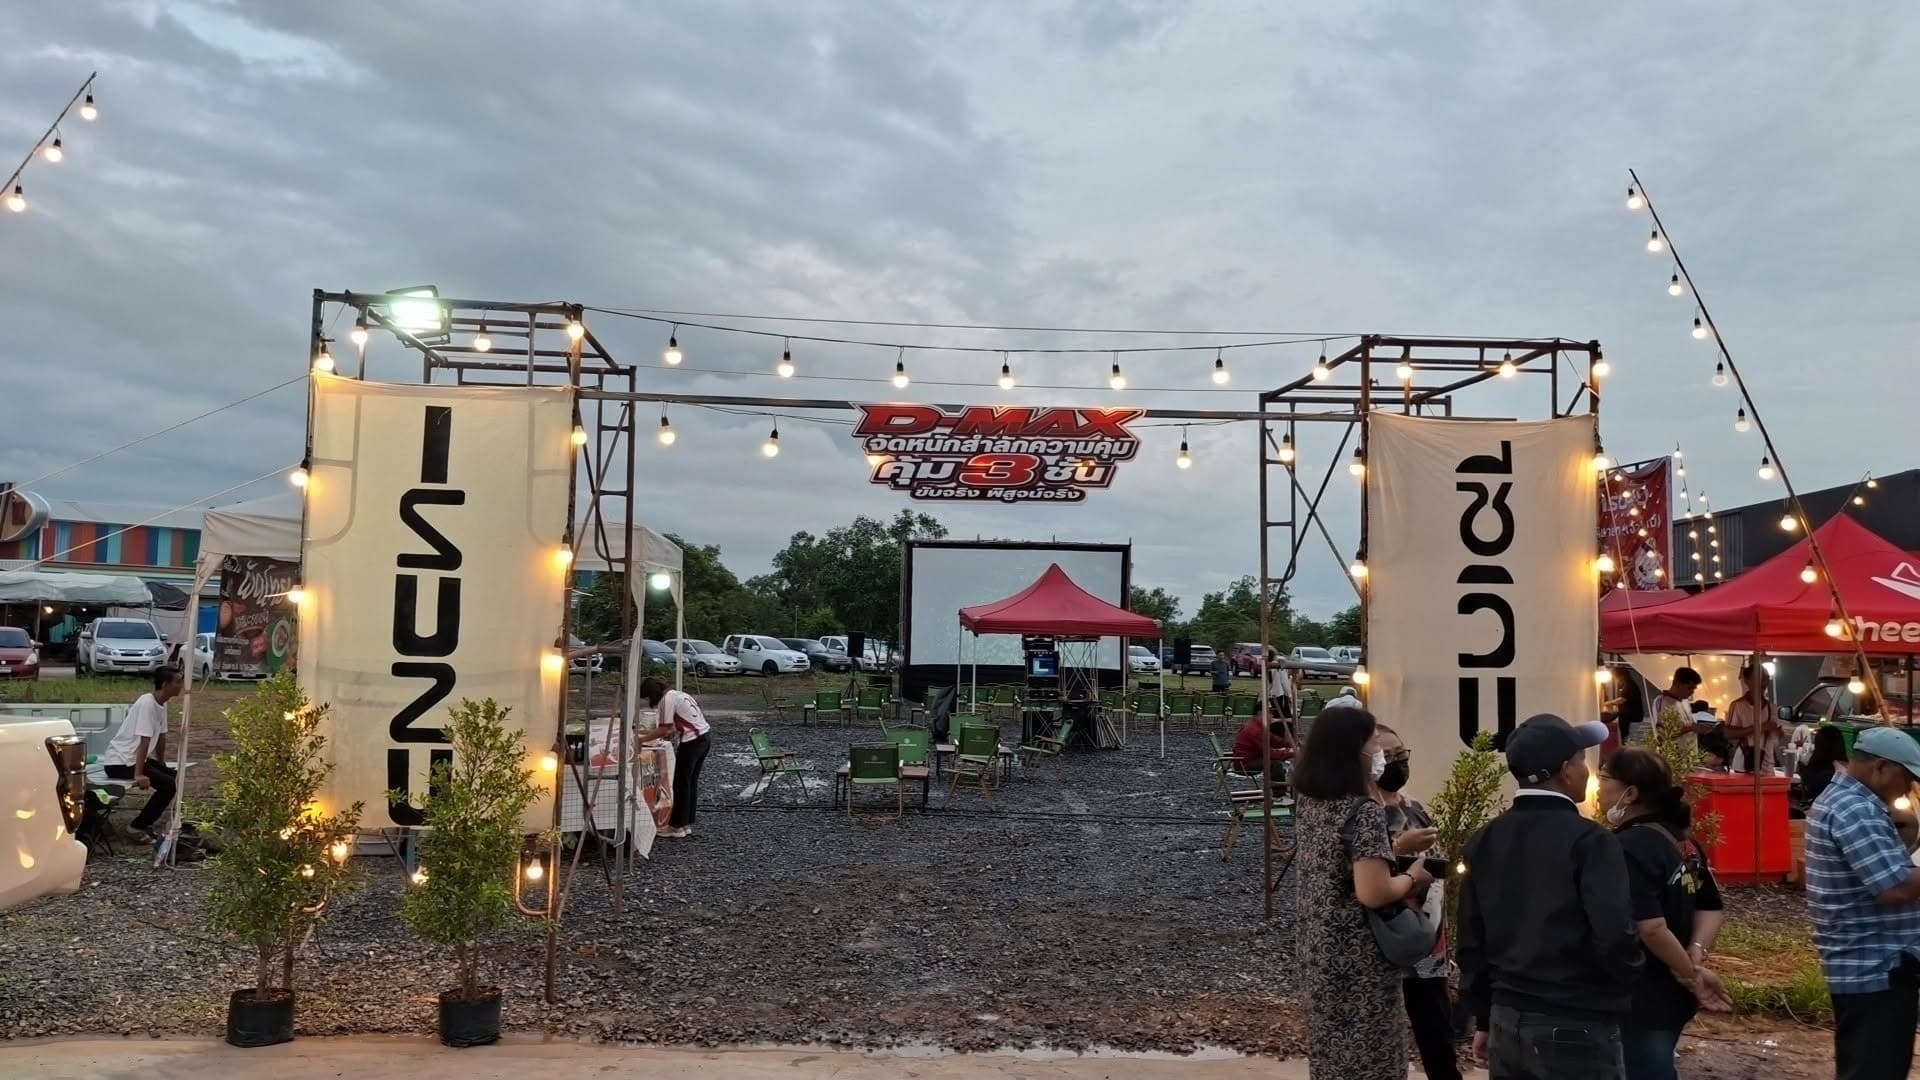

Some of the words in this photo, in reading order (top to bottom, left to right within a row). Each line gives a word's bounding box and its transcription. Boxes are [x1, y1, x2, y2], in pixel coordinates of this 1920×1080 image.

[858, 404, 1141, 438] D-MAX
[877, 454, 956, 486] คุ้ม
[958, 452, 1041, 487] 3
[1043, 456, 1106, 483] ชั้น
[388, 405, 466, 826] ISUZU
